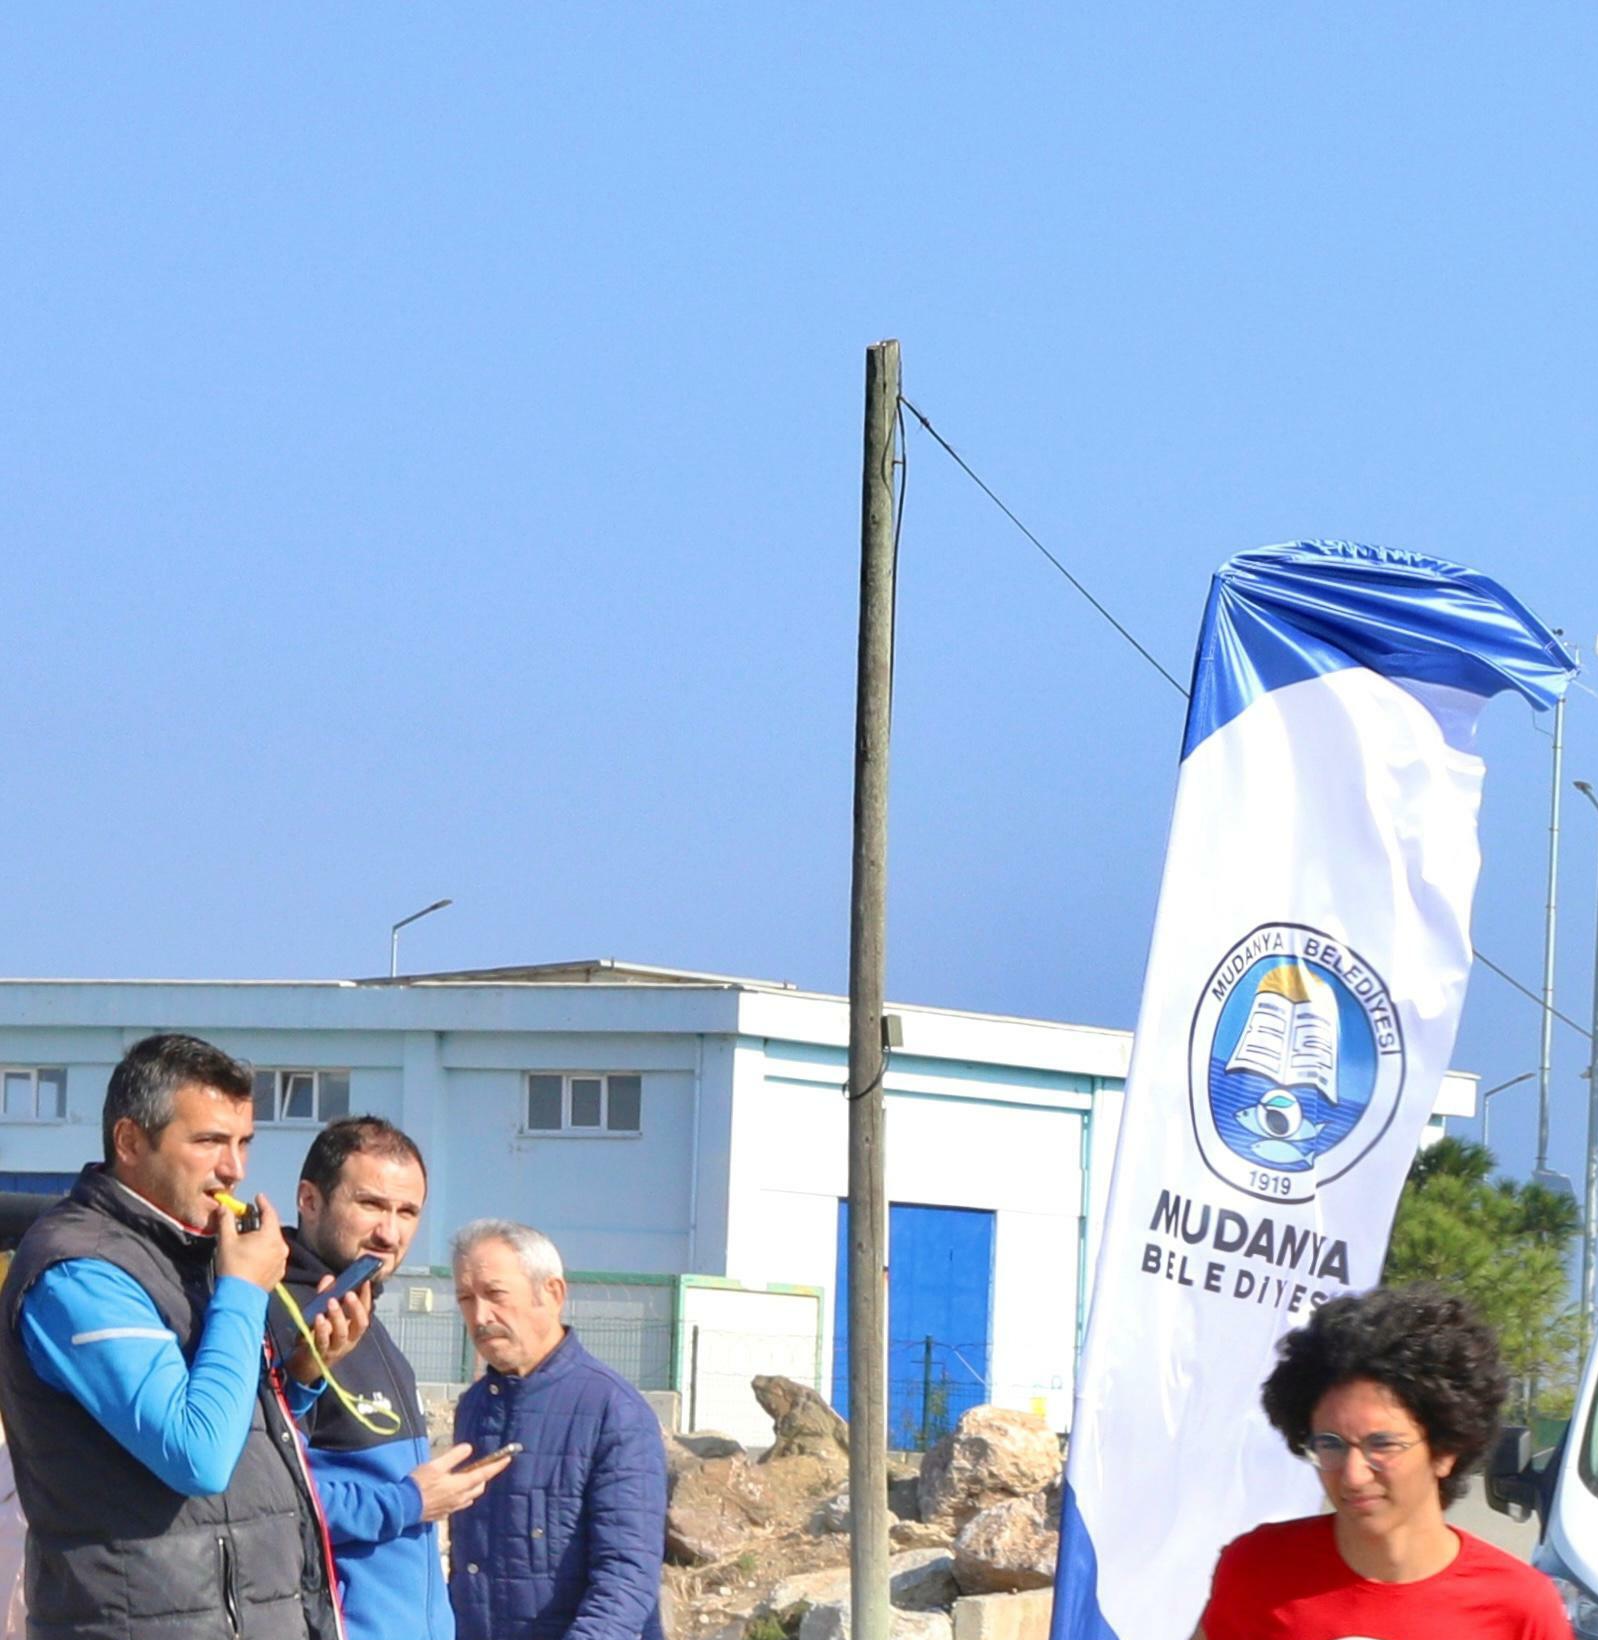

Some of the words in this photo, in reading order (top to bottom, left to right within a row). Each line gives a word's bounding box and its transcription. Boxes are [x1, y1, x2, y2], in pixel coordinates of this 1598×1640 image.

[1212, 932, 1284, 1001] MUDANYA
[1249, 1172, 1292, 1196] 1919
[1149, 1189, 1349, 1286] MUDANYA
[1141, 1243, 1329, 1314] BELEDİYES
